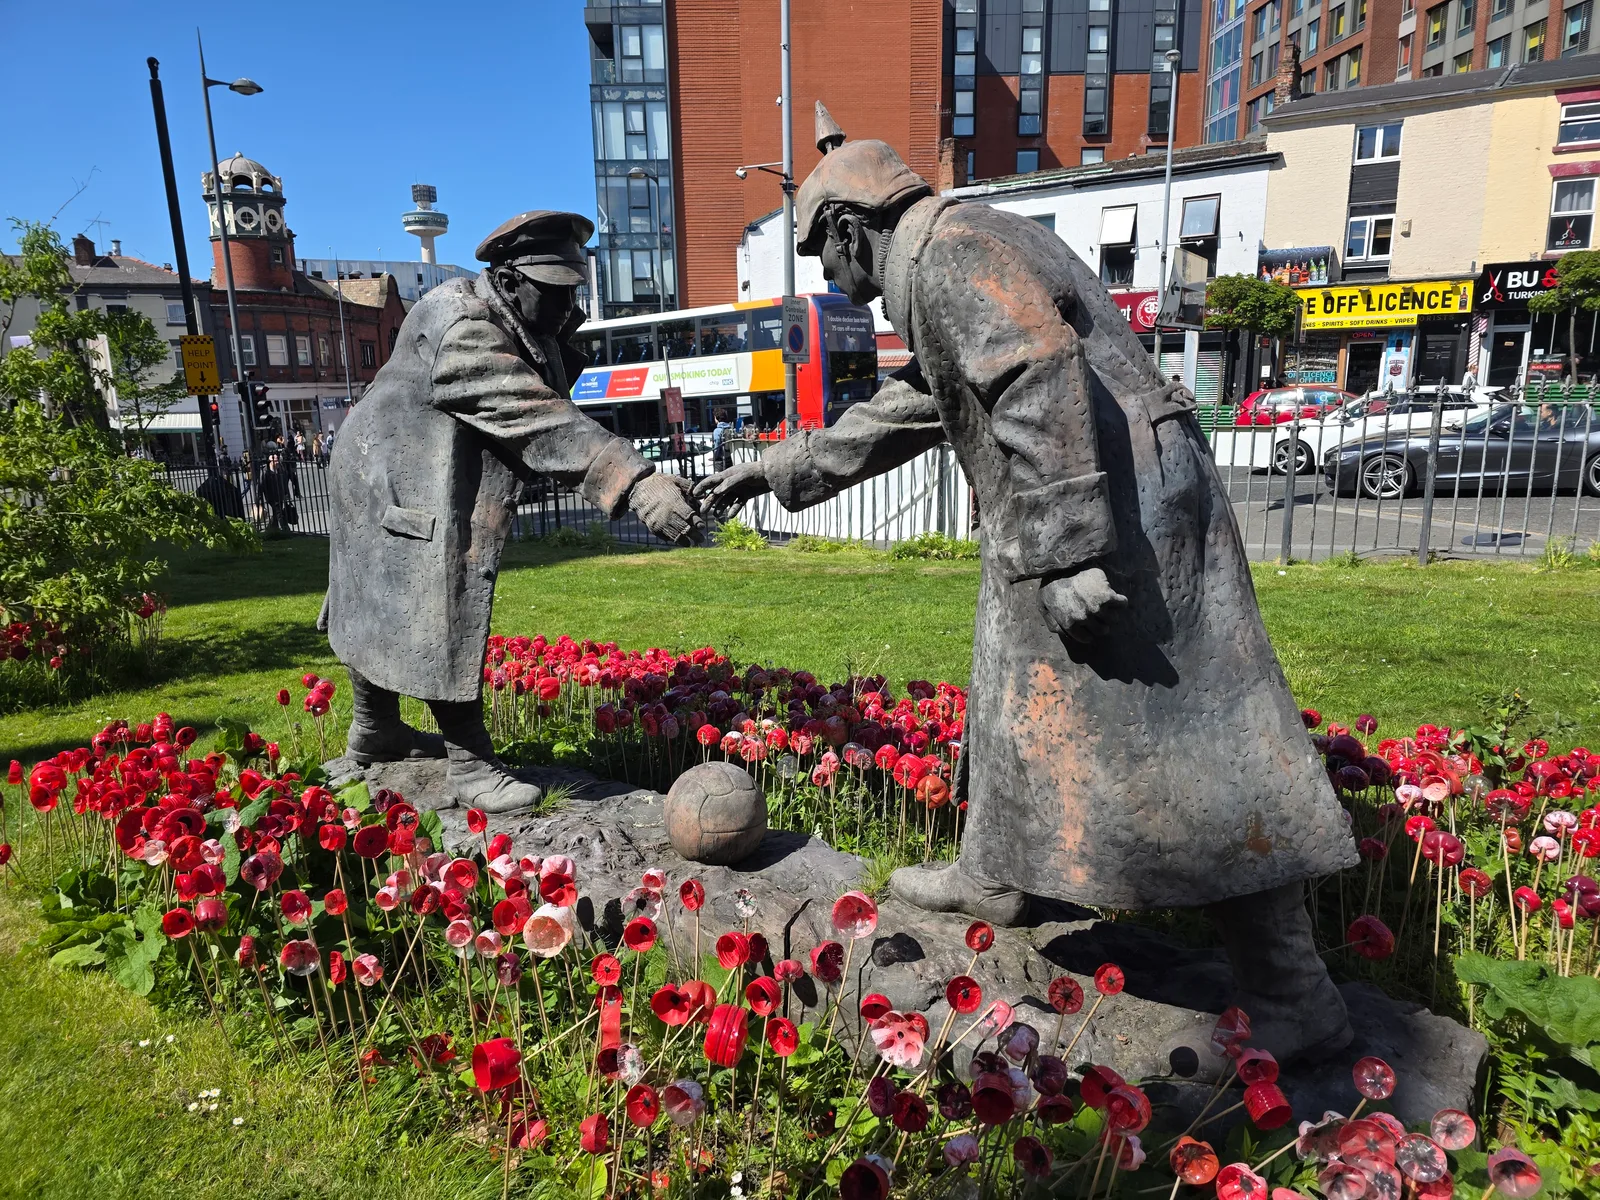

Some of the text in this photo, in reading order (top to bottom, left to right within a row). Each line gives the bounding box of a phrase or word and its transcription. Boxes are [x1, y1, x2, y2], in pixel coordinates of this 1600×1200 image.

[1506, 270, 1540, 289] BU
[1507, 290, 1547, 300] TURKIS
[1323, 295, 1359, 315] OFF
[1366, 290, 1453, 313] LICENCE
[785, 305, 807, 314] Controlled
[788, 314, 804, 323] ZONE
[830, 315, 842, 323] double
[1419, 314, 1454, 322] ORISTS
[1352, 331, 1374, 339] OPEN
[187, 361, 215, 369] POINT
[653, 371, 669, 382] QUI
[671, 369, 707, 380] SMOKING
[707, 367, 732, 377] TODAY
